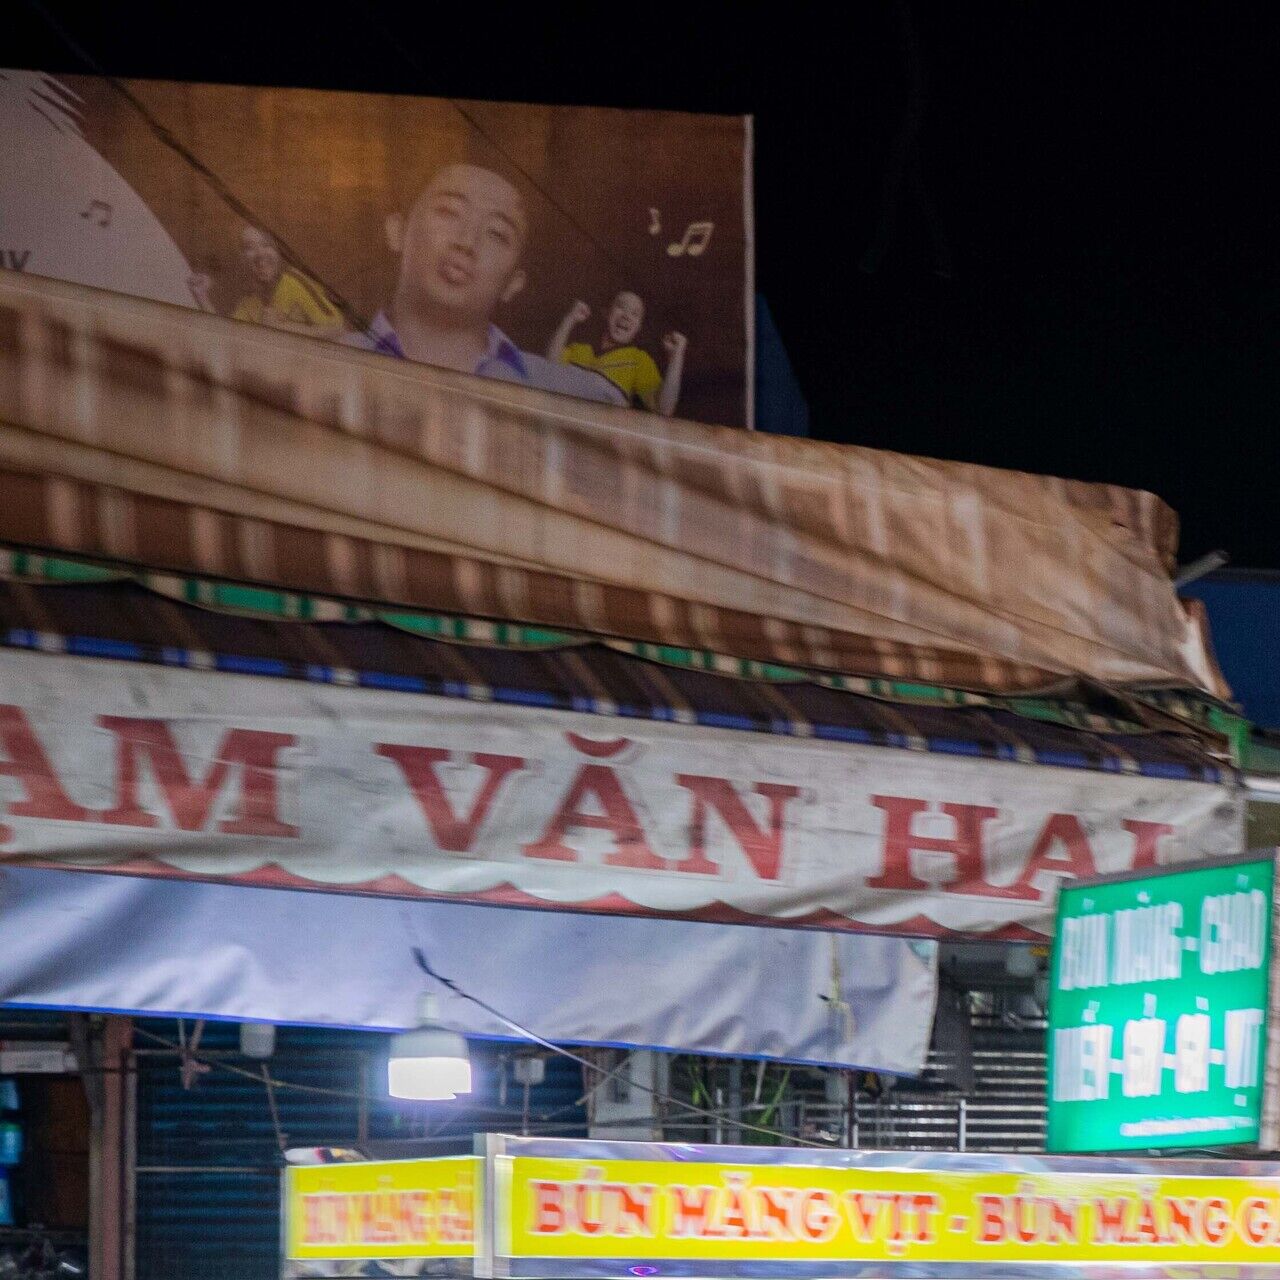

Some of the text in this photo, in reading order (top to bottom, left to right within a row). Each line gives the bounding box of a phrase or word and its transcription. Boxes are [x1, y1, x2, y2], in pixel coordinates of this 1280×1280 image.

[374, 731, 800, 881] VĂN
[527, 1166, 660, 1238] BÚN
[666, 1170, 841, 1243] MĂNG
[848, 1191, 941, 1255] VỊT
[974, 1181, 1078, 1245] BÚN
[1090, 1180, 1235, 1248] MĂNG
